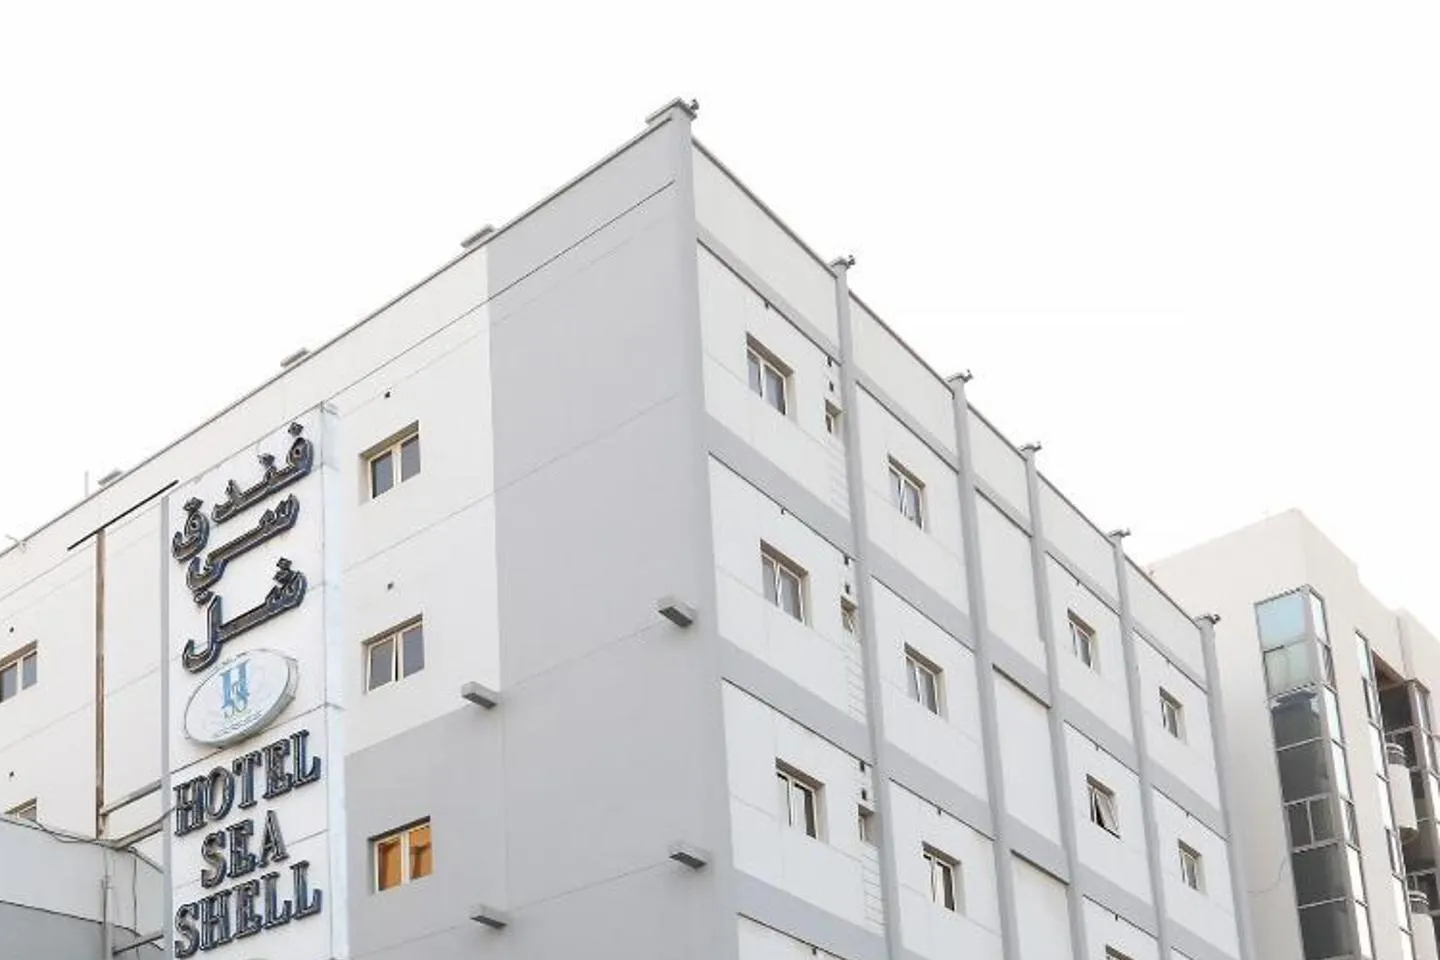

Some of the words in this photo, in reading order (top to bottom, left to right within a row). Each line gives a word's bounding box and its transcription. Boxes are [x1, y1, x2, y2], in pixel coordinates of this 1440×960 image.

[172, 422, 314, 563] فندق
[186, 494, 301, 606] سي
[173, 729, 322, 837] HOTEL
[201, 810, 290, 889] SEA
[174, 860, 323, 960] SHELL
